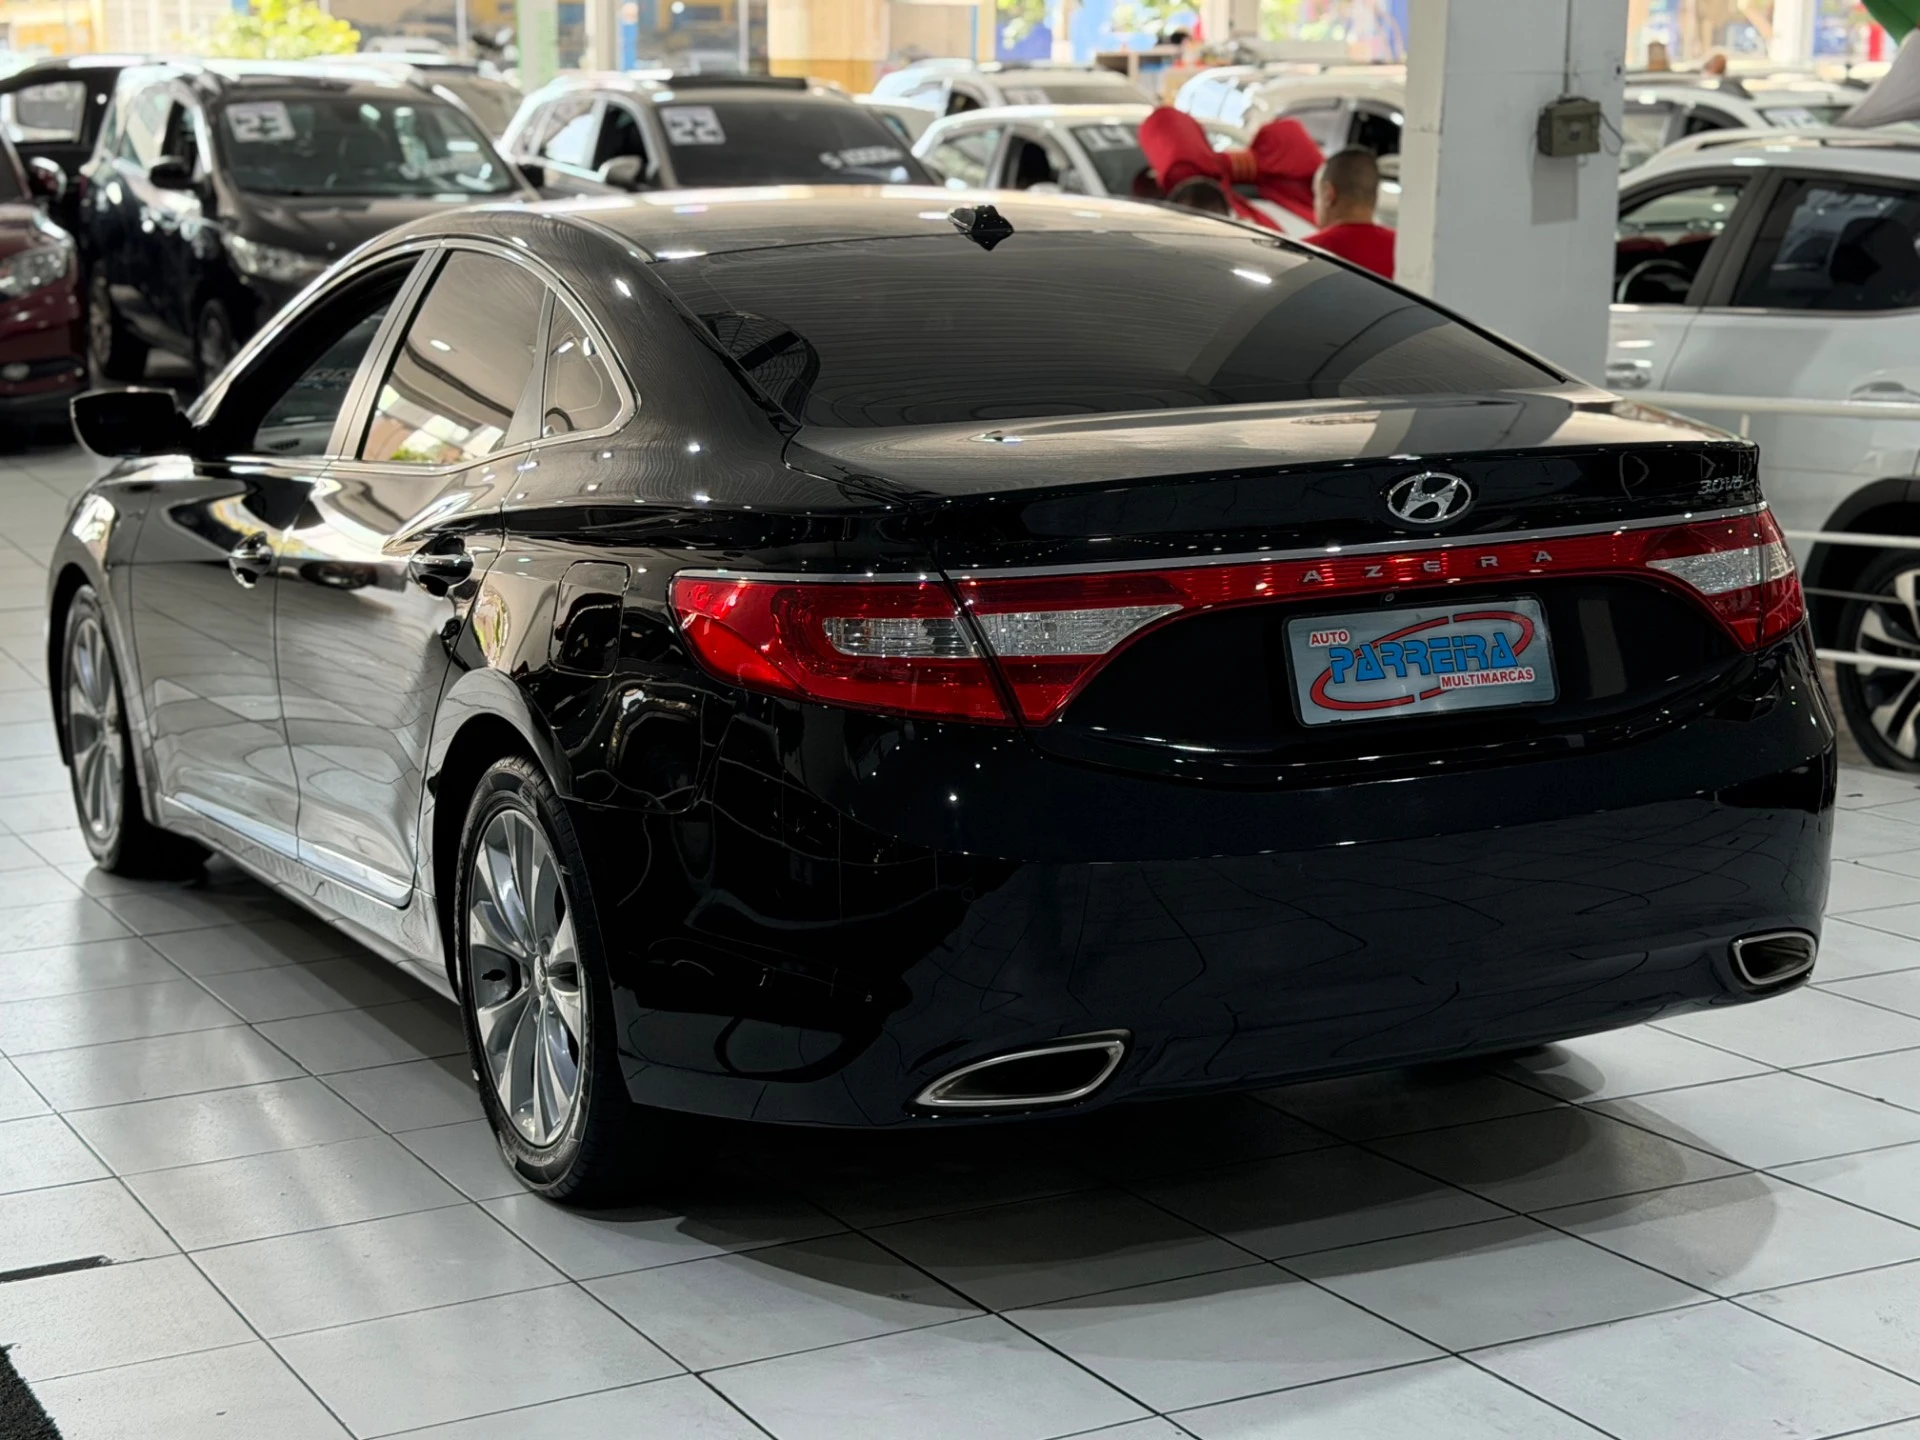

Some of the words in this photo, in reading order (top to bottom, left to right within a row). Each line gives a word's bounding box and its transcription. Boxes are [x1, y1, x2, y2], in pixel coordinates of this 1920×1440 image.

[1303, 550, 1553, 583] AZERA
[1311, 630, 1349, 645] AUTO
[1328, 632, 1519, 684] PARREIRA
[1440, 667, 1534, 688] MULTIMARCAS
